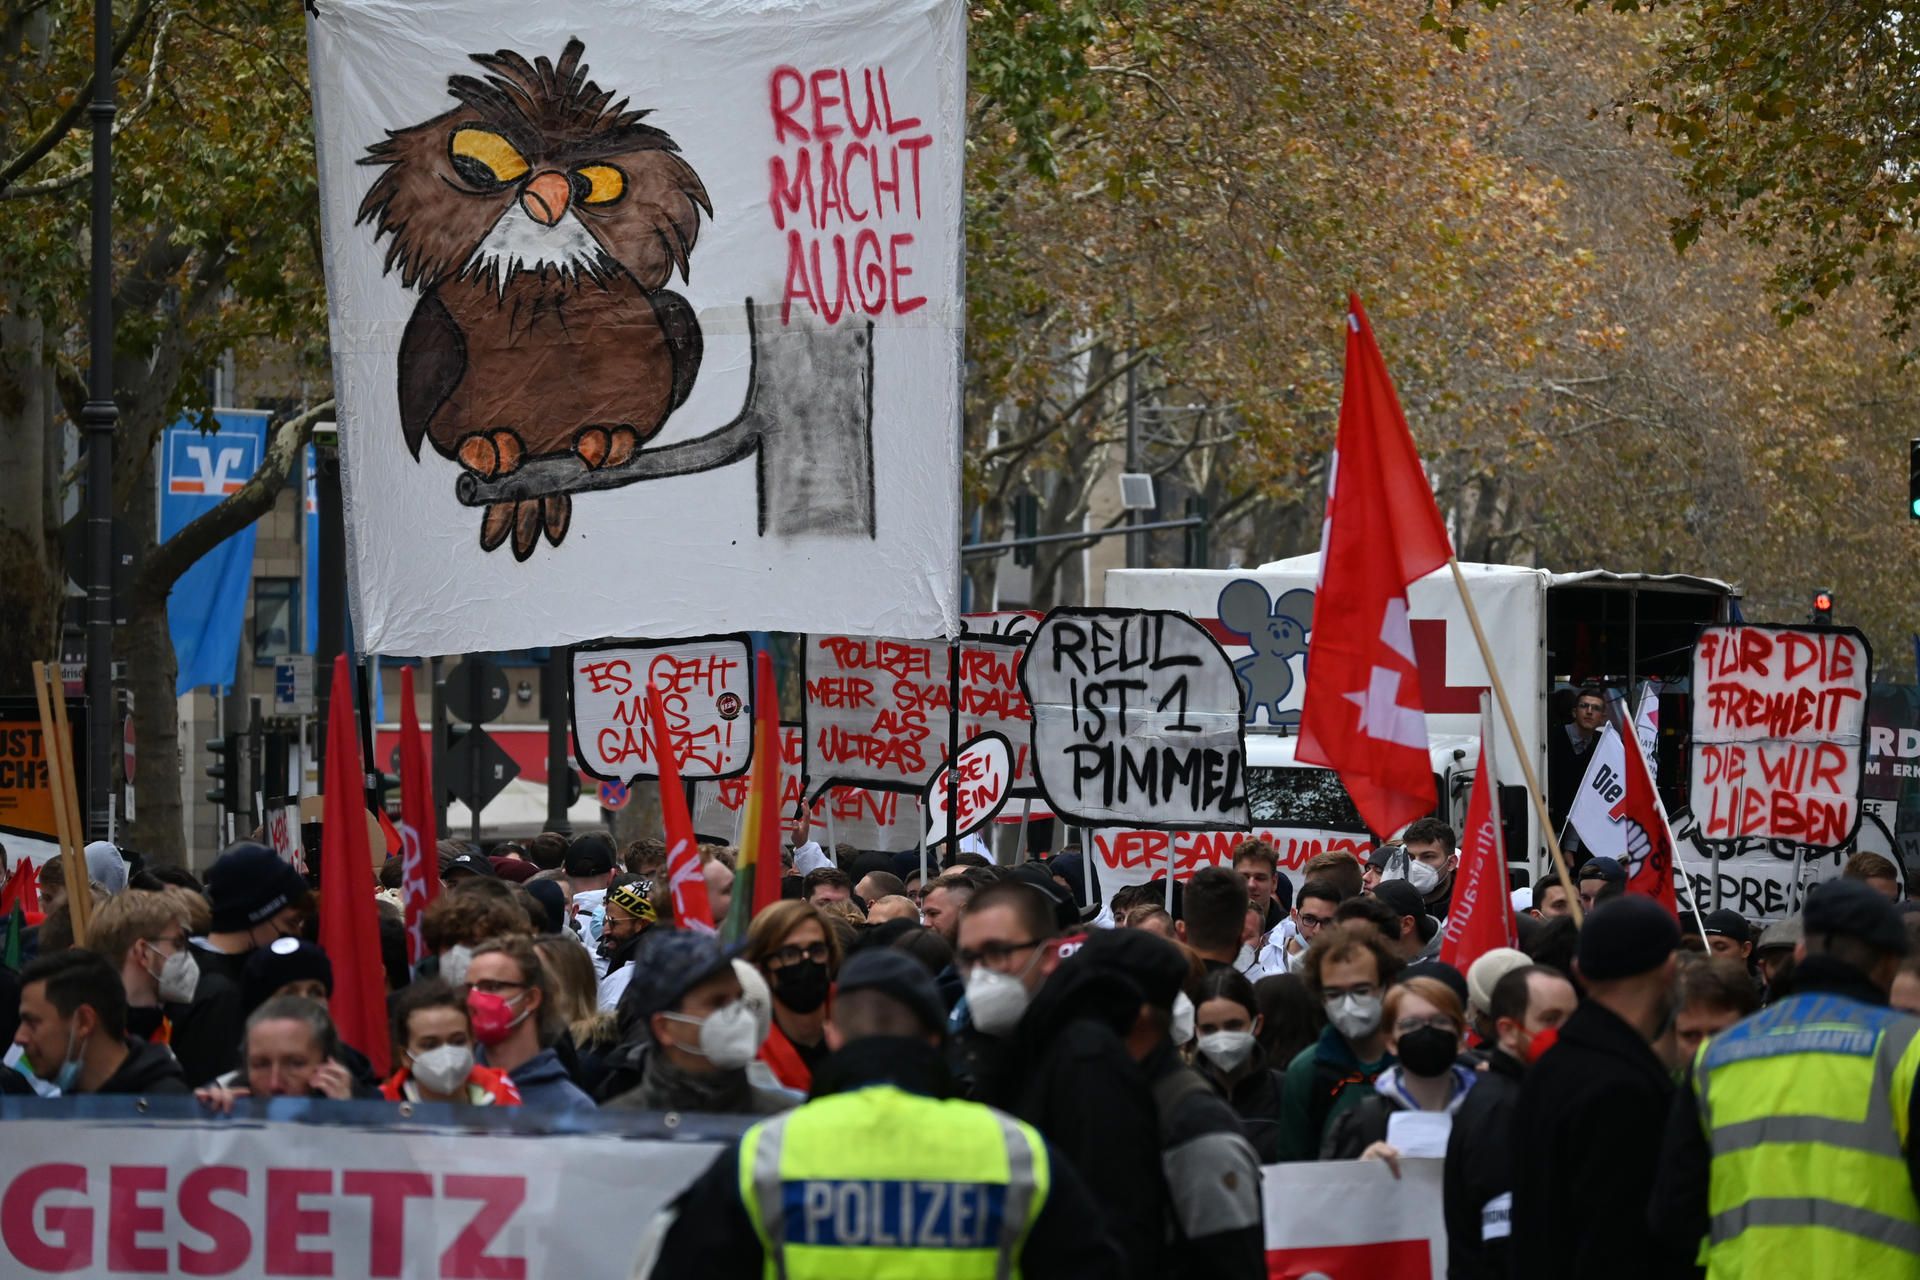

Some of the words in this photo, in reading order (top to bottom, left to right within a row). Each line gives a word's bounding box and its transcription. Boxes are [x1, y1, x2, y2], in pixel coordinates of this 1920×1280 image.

[769, 63, 922, 144] REUL
[768, 134, 933, 230] MACHT
[780, 228, 928, 326] AUGE
[819, 636, 931, 680] POLIZEI
[1053, 614, 1203, 676] REUL
[1700, 627, 1773, 681] FÜR
[1776, 631, 1856, 683] DIE
[579, 660, 633, 695] ES
[649, 653, 738, 696] GEHT
[806, 676, 876, 709] MEHR
[871, 708, 931, 742] ALS
[1070, 678, 1148, 742] IST
[1157, 674, 1202, 732] 1
[1708, 682, 1862, 738] FREIHEIT
[817, 724, 926, 775] ULTRAS
[1063, 741, 1248, 812] PIMMEL
[1701, 744, 1747, 784] DIE
[1758, 743, 1847, 794] WIR
[1591, 763, 1624, 804] Die
[1707, 786, 1847, 845] LIEBEN
[1094, 829, 1377, 871] VERSAMLUS
[1673, 867, 1821, 917] REPRES
[0, 1162, 528, 1280] GESETZ
[805, 1182, 987, 1245] POLIZEI
